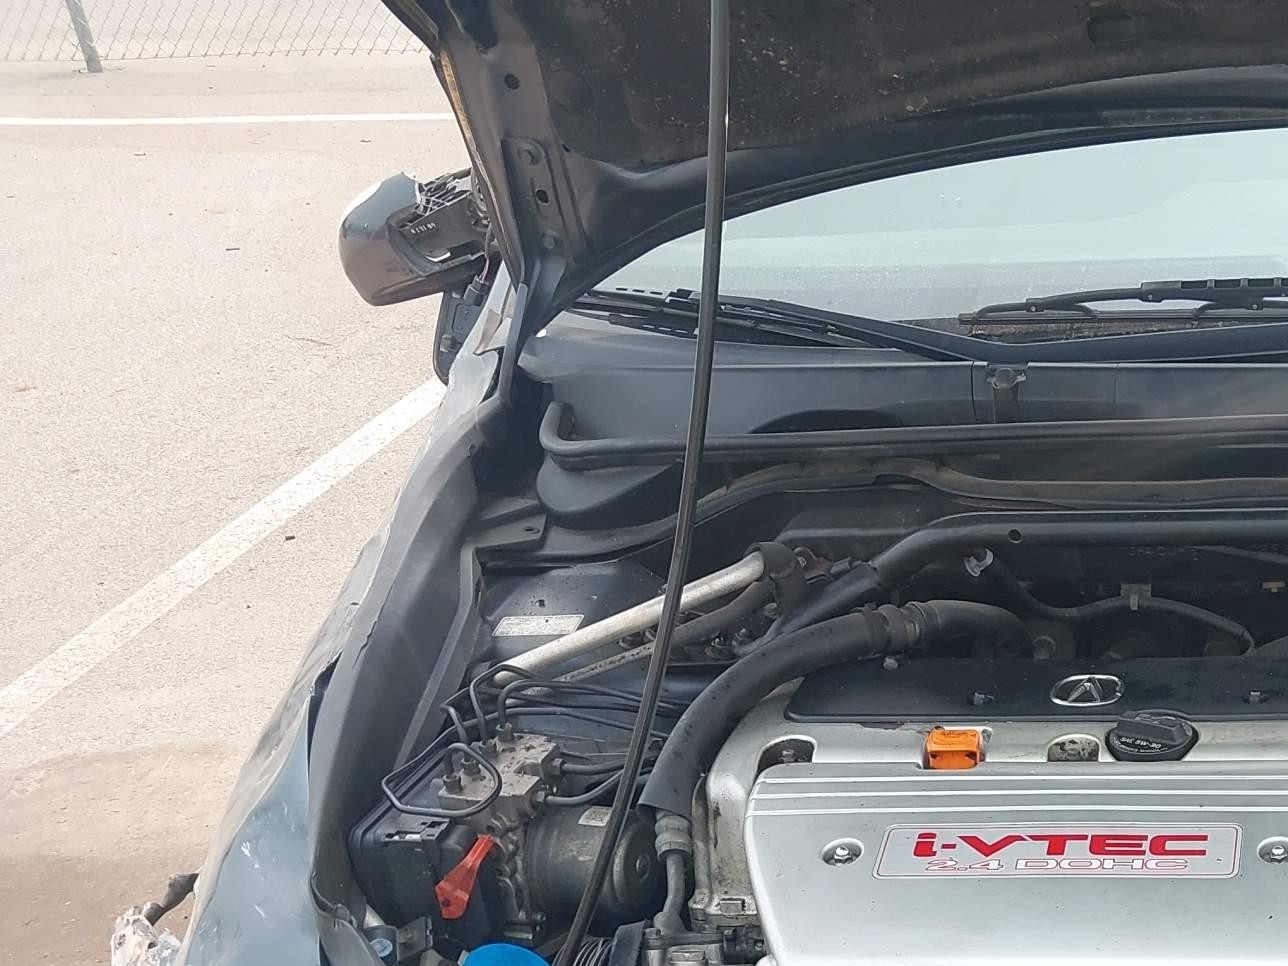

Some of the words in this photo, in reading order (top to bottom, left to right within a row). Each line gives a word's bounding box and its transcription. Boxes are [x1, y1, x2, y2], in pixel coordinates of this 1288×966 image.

[913, 832, 1208, 857] i-VTEC
[925, 858, 1003, 872] 2.4
[1015, 858, 1188, 871] DOHC
